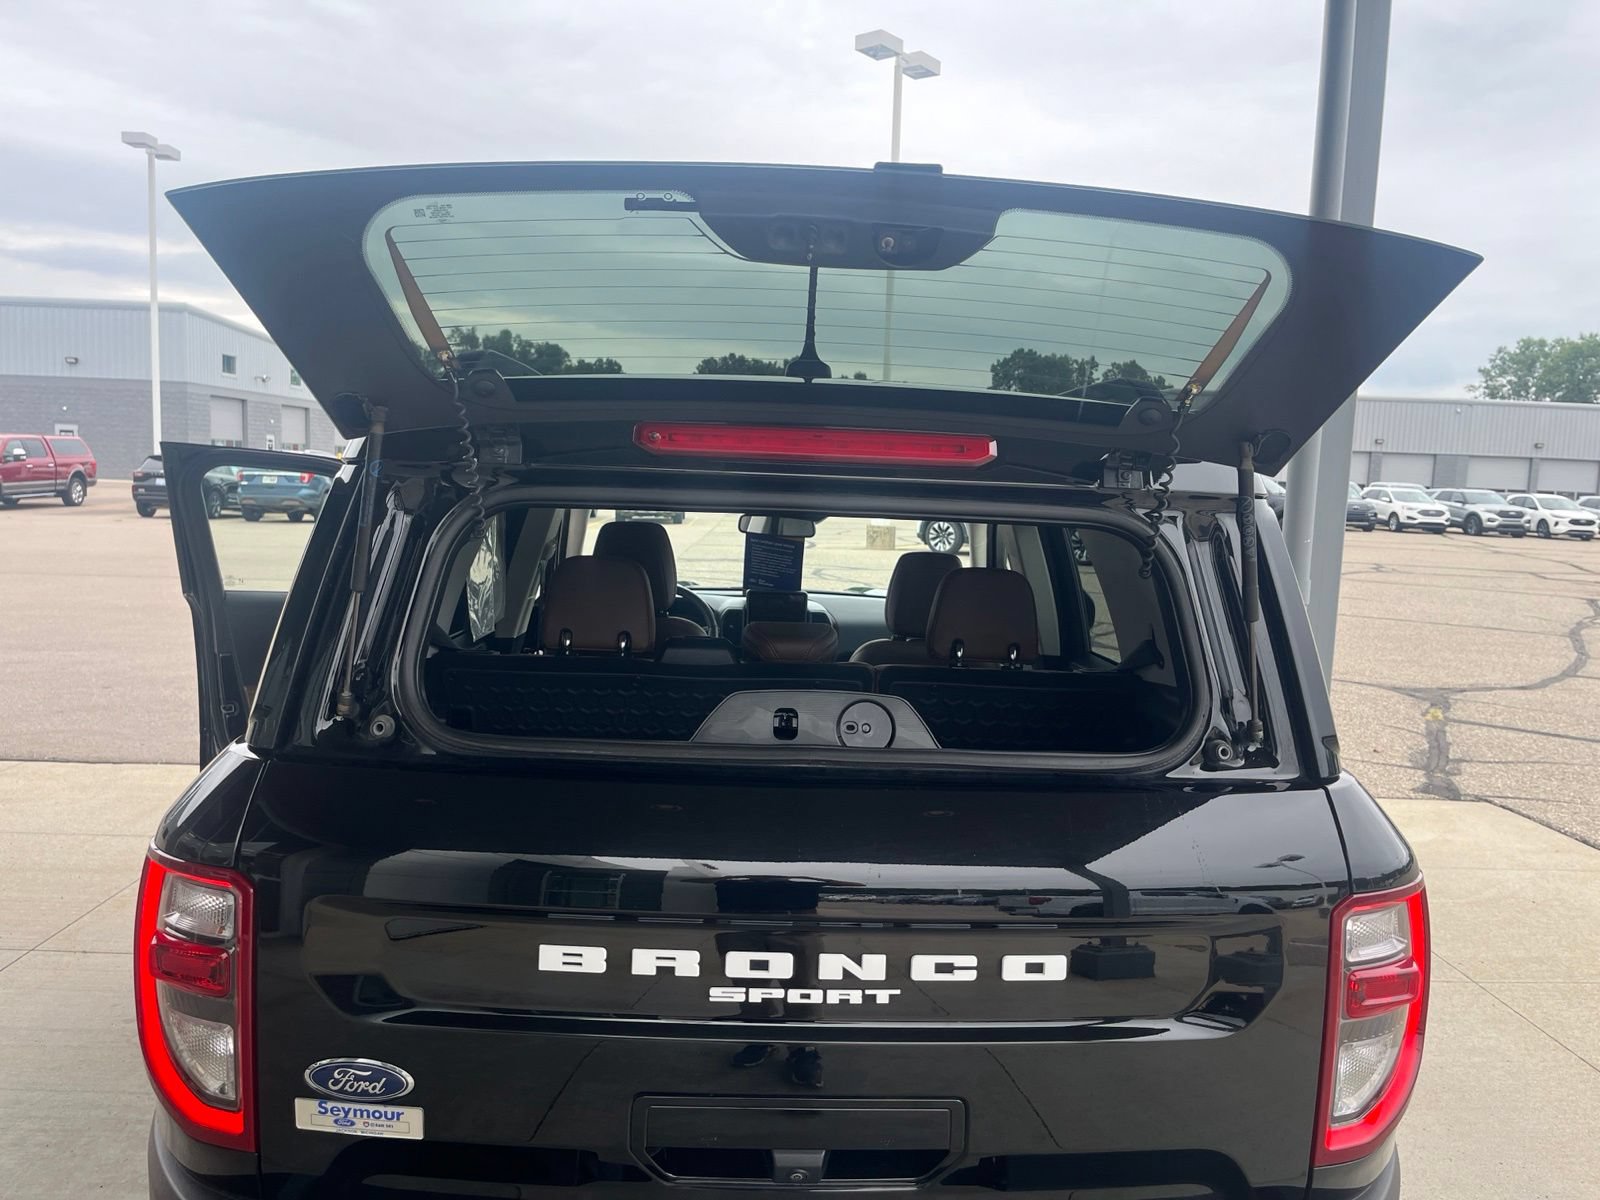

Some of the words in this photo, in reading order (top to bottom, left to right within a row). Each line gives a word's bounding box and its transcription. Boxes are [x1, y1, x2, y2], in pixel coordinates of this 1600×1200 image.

[538, 943, 1067, 982] BRONCO
[709, 987, 901, 1004] SPORT
[328, 1067, 386, 1094] Ford
[318, 1101, 404, 1121] Seymour
